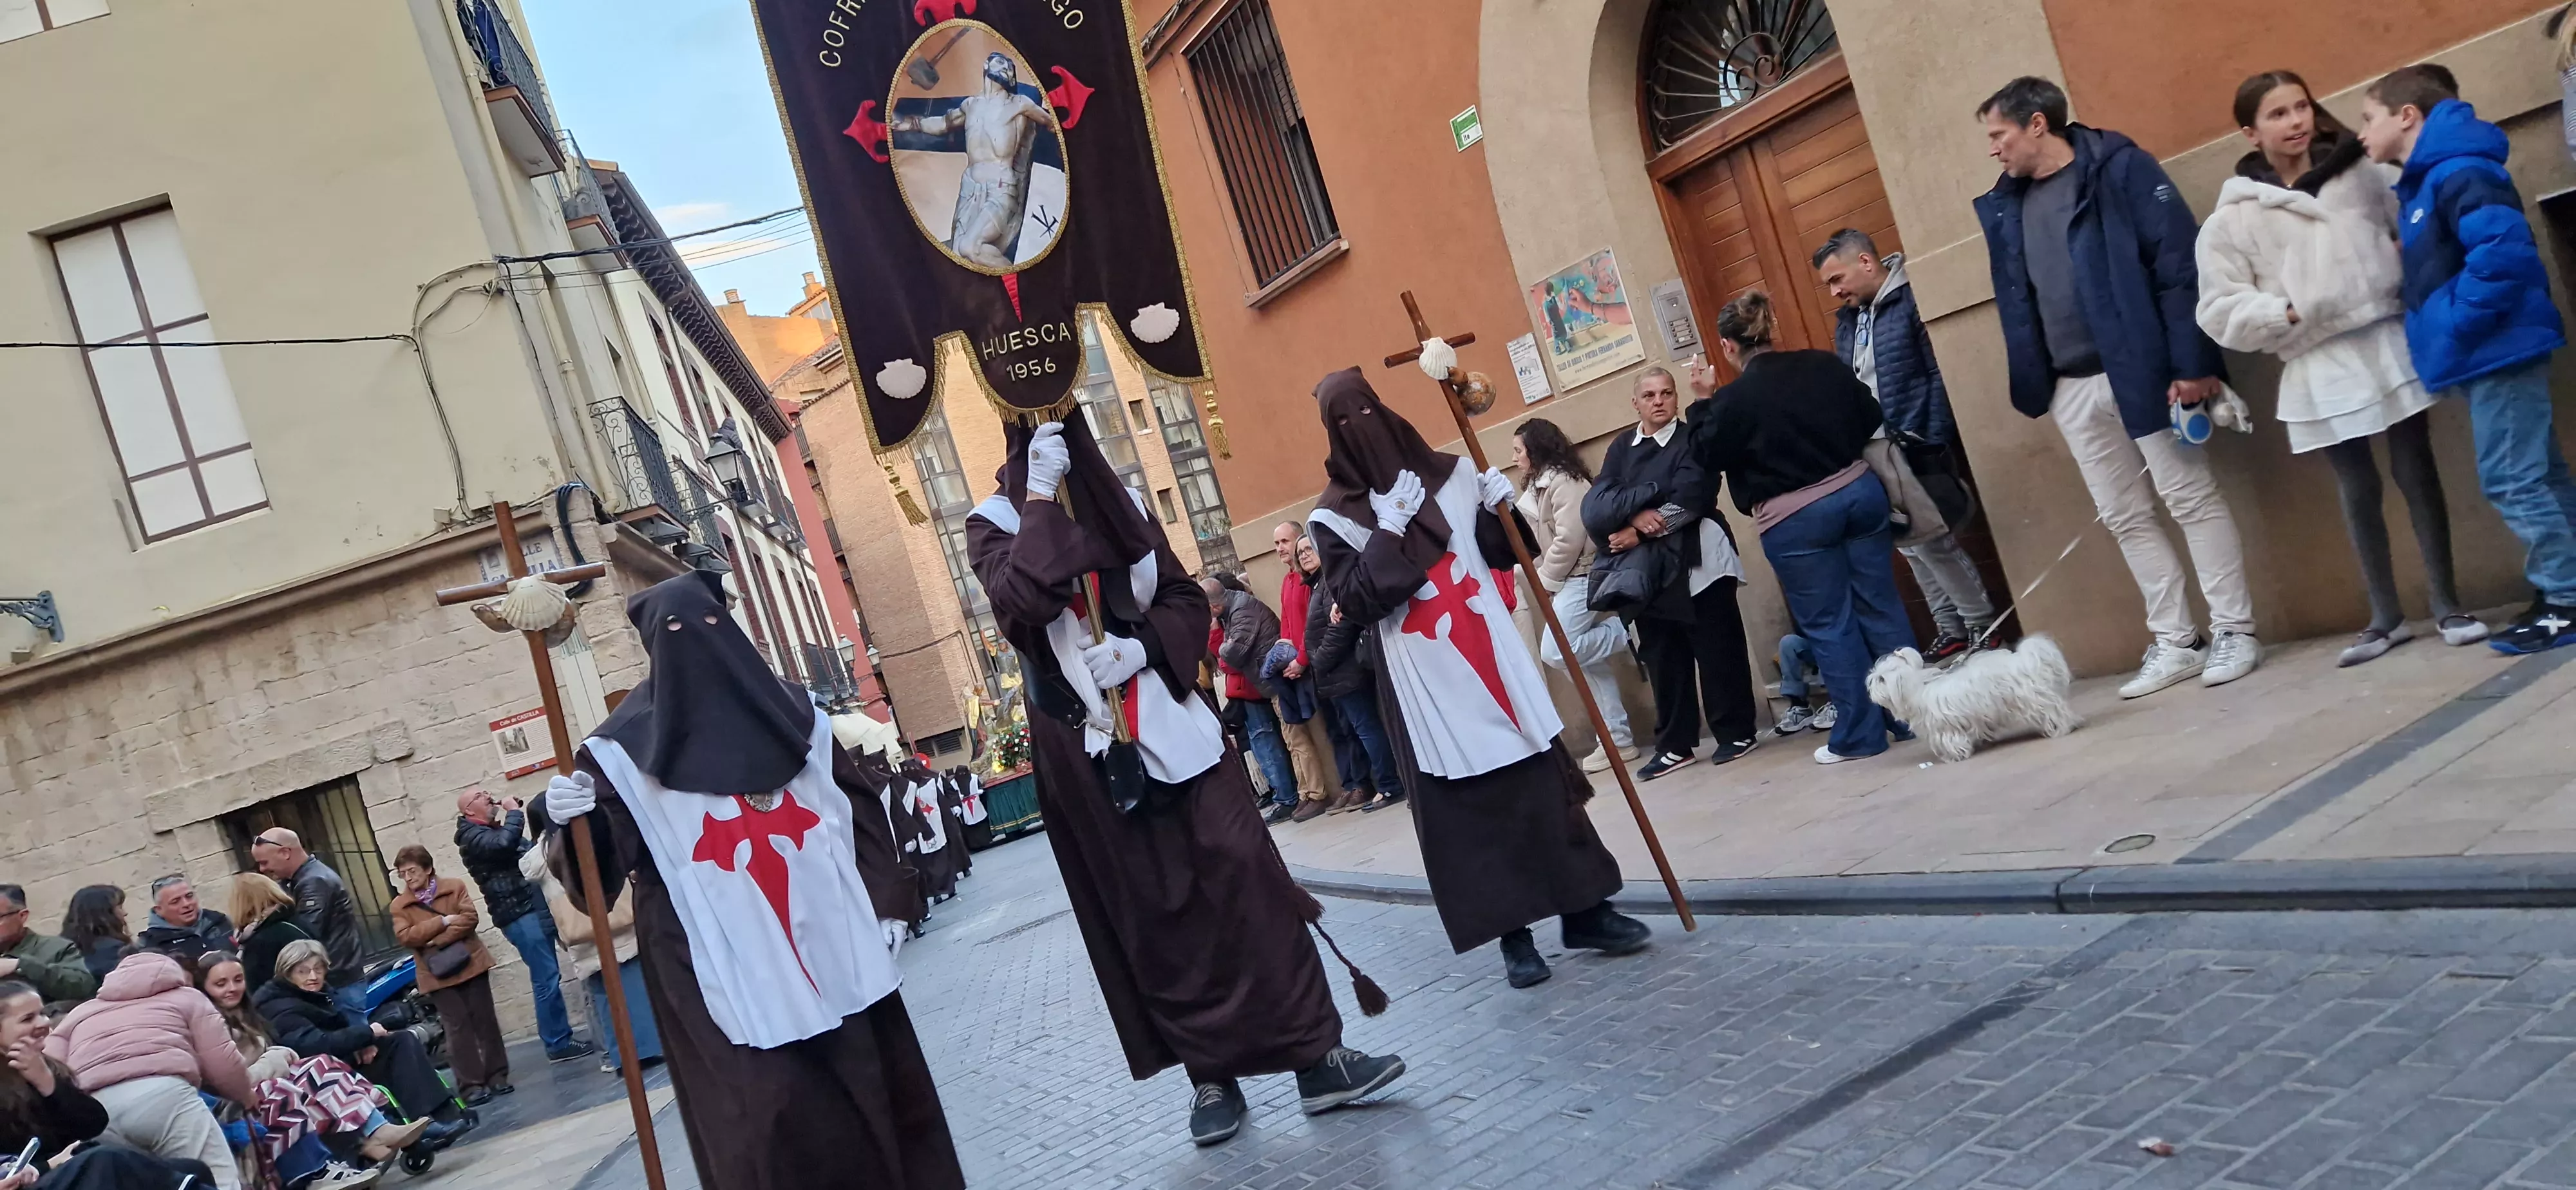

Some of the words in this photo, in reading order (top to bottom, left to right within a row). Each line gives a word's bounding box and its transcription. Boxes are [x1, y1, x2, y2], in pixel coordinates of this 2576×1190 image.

[819, 0, 866, 67] COFR
[1043, 0, 1084, 29] GO
[981, 322, 1072, 361] HUESCA
[1006, 357, 1056, 382] 1956
[516, 710, 540, 721] CASTILLA
